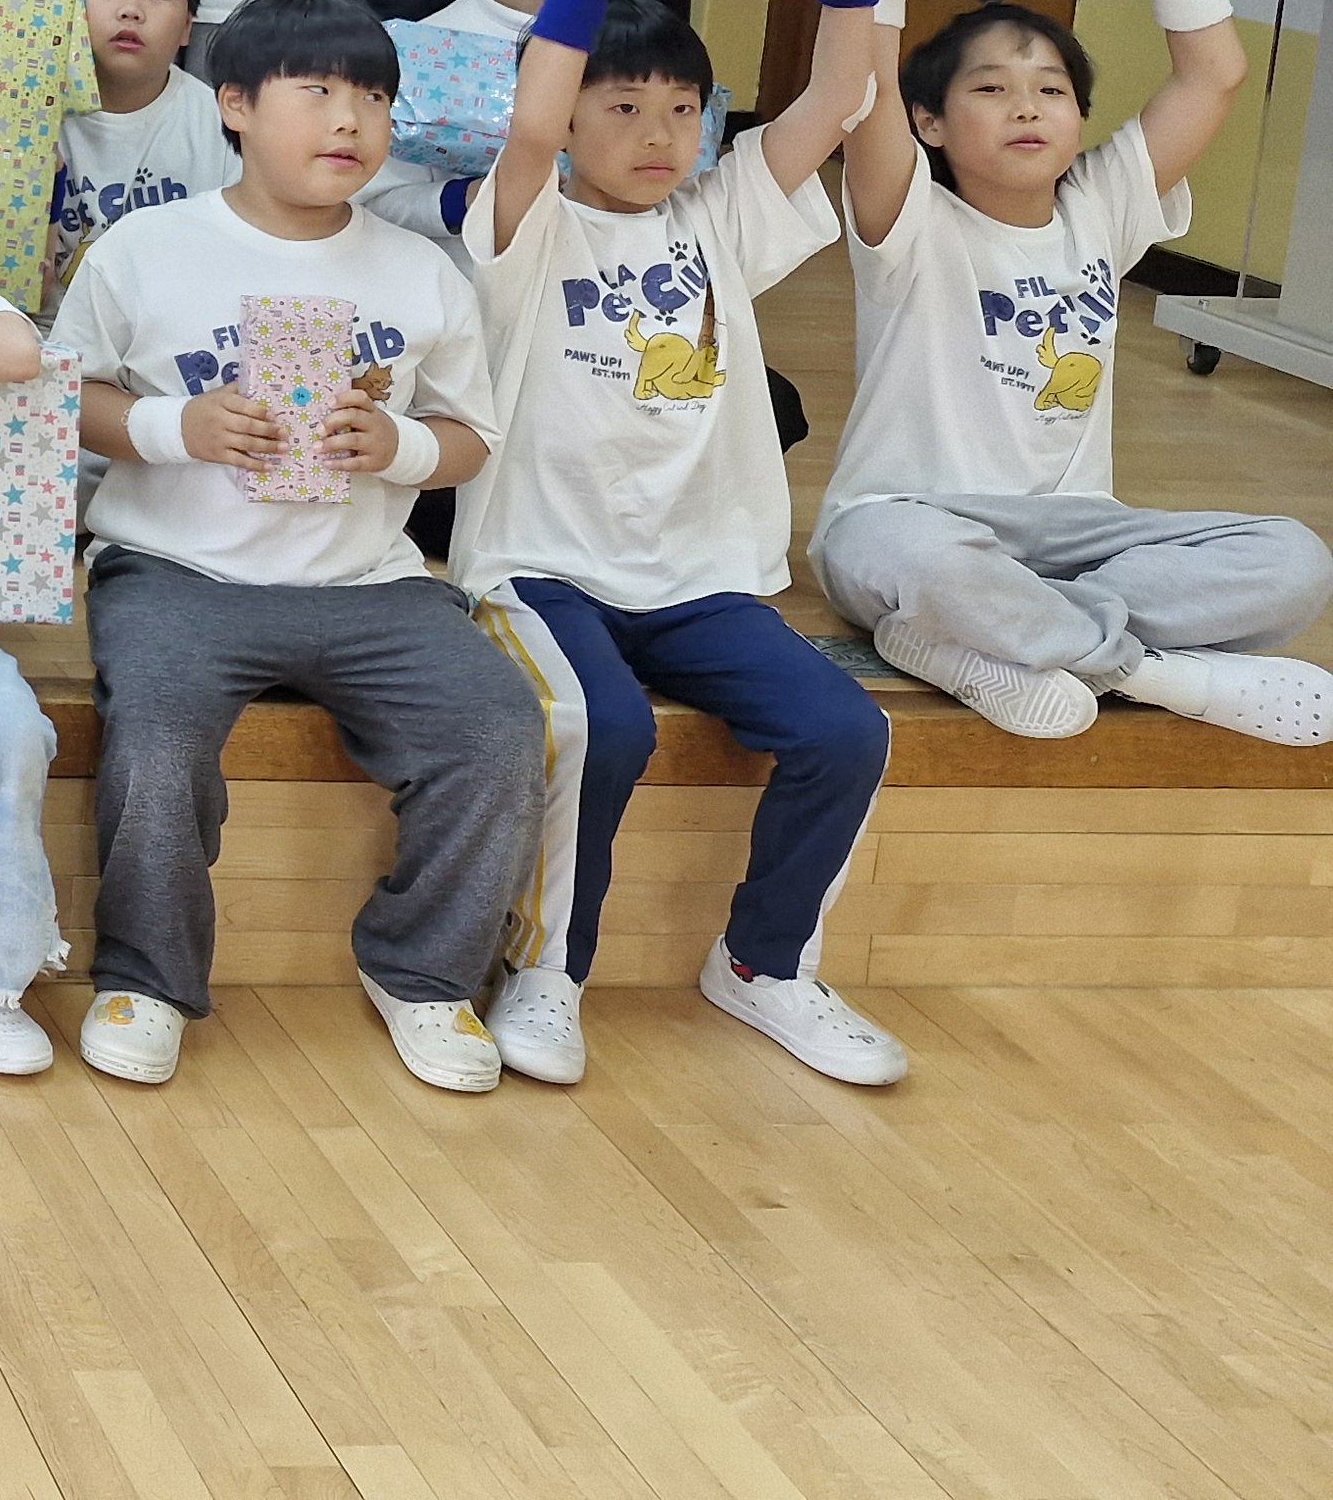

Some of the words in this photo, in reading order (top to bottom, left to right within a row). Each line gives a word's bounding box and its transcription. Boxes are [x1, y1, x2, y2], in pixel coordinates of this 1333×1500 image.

[66, 176, 97, 198] ILA
[60, 199, 96, 232] et
[978, 290, 1069, 338] Pet
[212, 323, 241, 351] FI
[564, 348, 597, 365] PAWS
